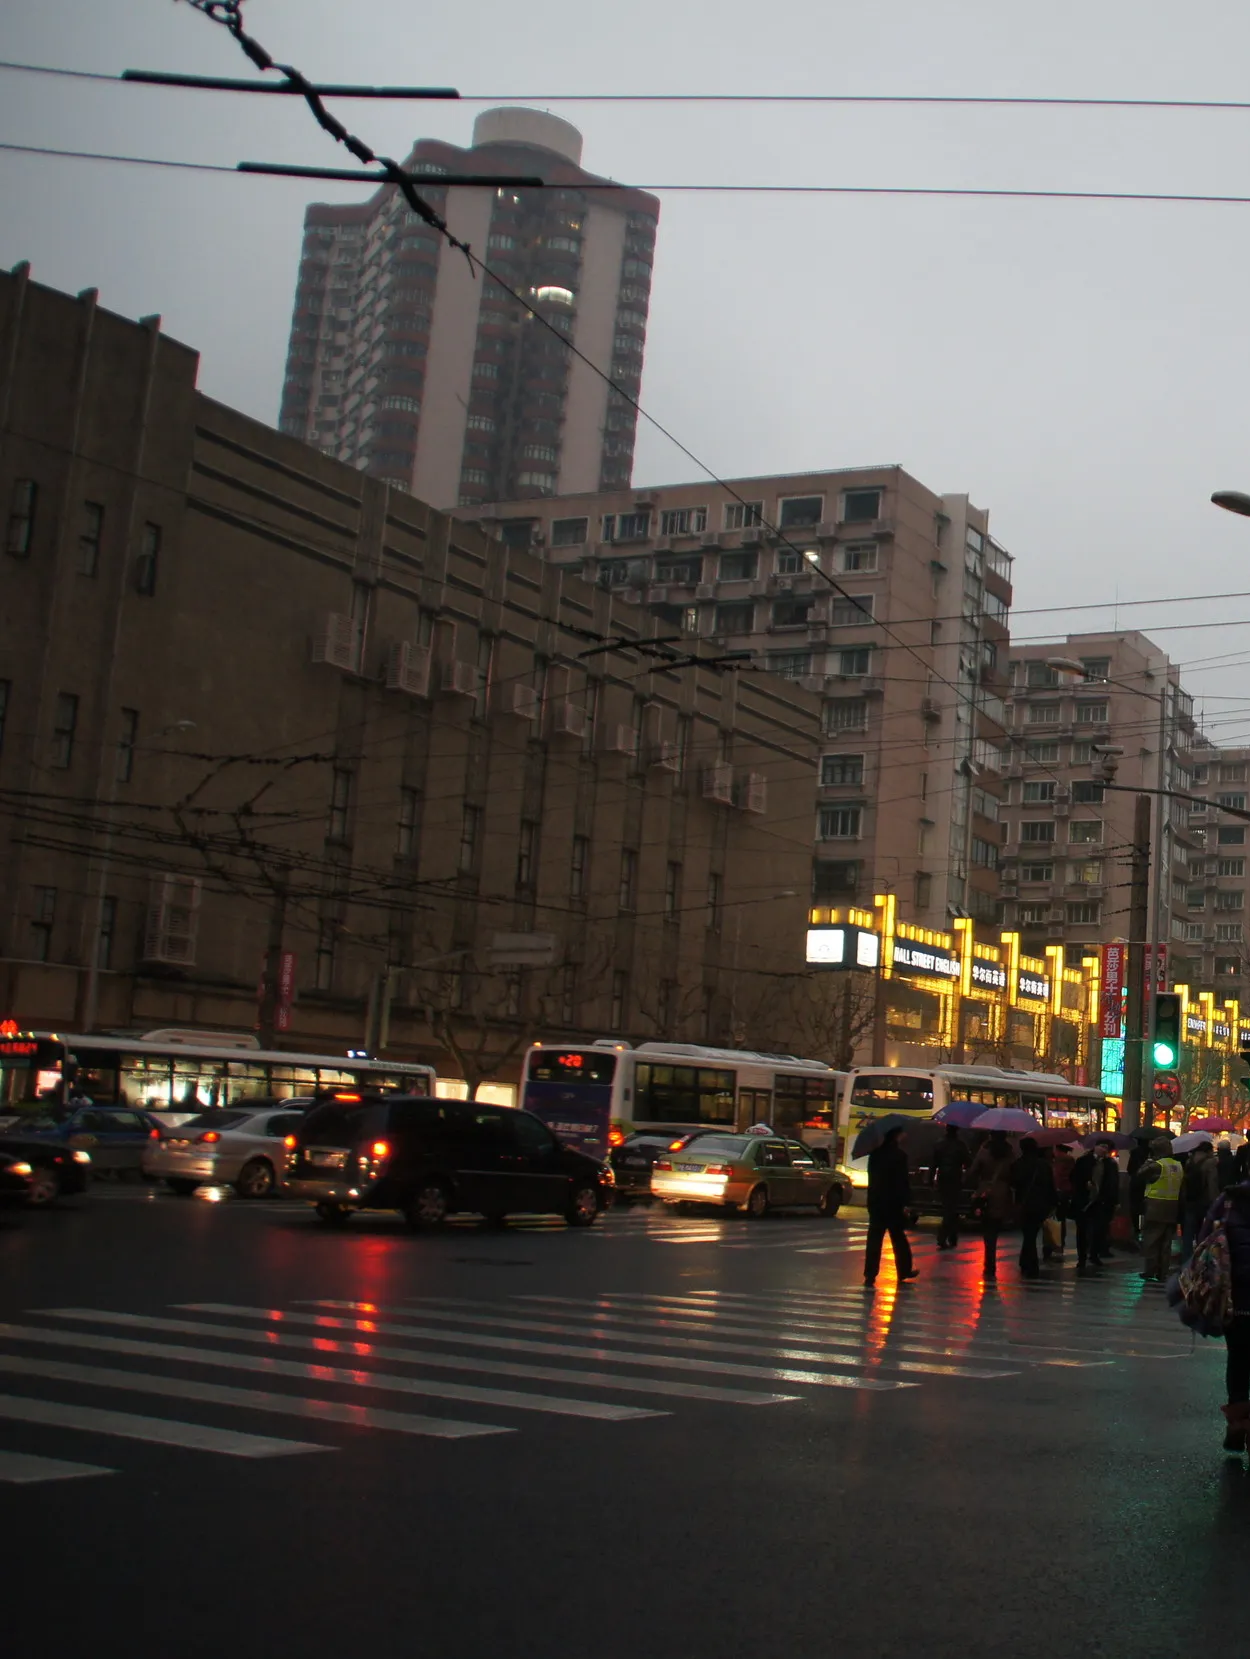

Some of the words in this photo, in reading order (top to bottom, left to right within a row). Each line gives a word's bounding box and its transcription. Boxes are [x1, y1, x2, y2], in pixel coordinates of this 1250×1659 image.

[911, 950, 935, 970] STREET
[935, 956, 961, 977] ENGLISH
[972, 965, 1006, 987] 华尔街英语
